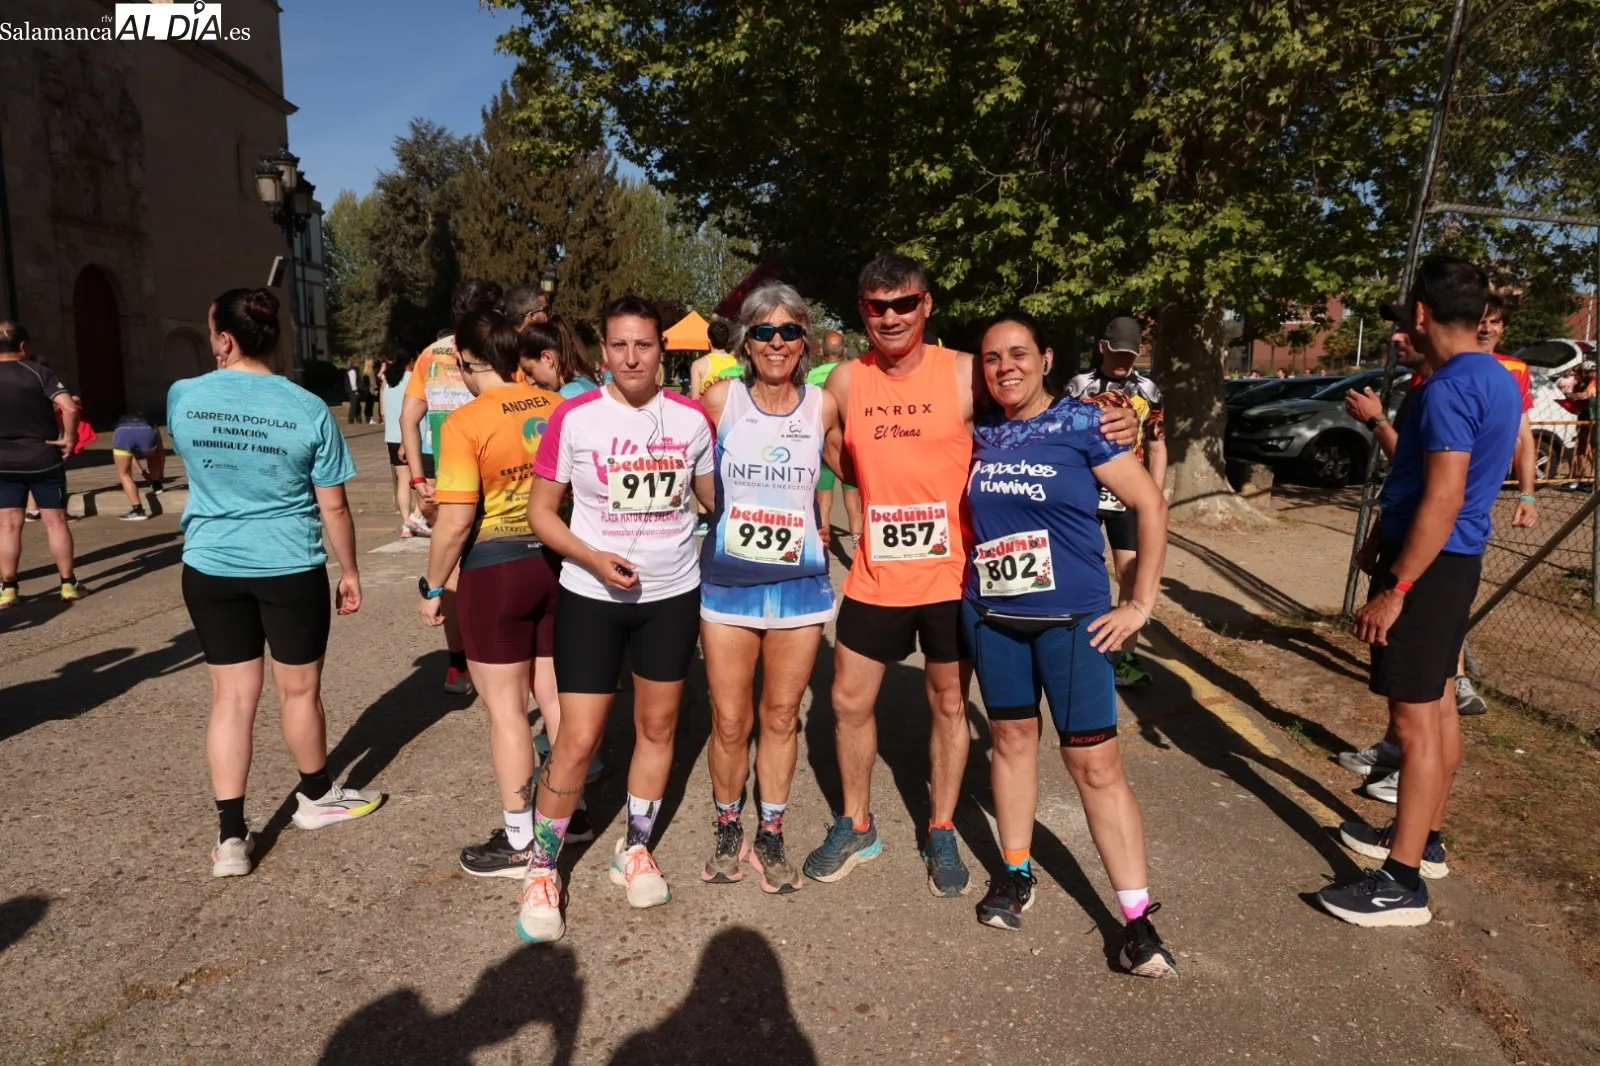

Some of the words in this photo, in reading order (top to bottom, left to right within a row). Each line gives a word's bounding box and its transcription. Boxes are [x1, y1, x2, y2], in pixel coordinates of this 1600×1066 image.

[501, 396, 551, 414] ANDREA
[864, 404, 932, 417] HYROX
[186, 410, 240, 423] CARRERA
[242, 415, 297, 430] POPULAR
[212, 426, 268, 440] FUNDACIÓN
[874, 424, 889, 440] El
[890, 424, 921, 438] Venas
[192, 439, 249, 452] RODRÍGUEZ
[500, 462, 534, 476] ESCUEL
[609, 456, 685, 472] bedunia
[728, 462, 816, 484] INFINITY
[980, 460, 1057, 480] apaches
[622, 471, 677, 499] 917
[980, 479, 1046, 502] running
[730, 505, 804, 528] bedunia
[871, 506, 945, 523] bedunia
[738, 523, 792, 552] 939
[882, 521, 935, 548] 857
[978, 535, 1048, 560] bedunia
[984, 552, 1039, 582] 802
